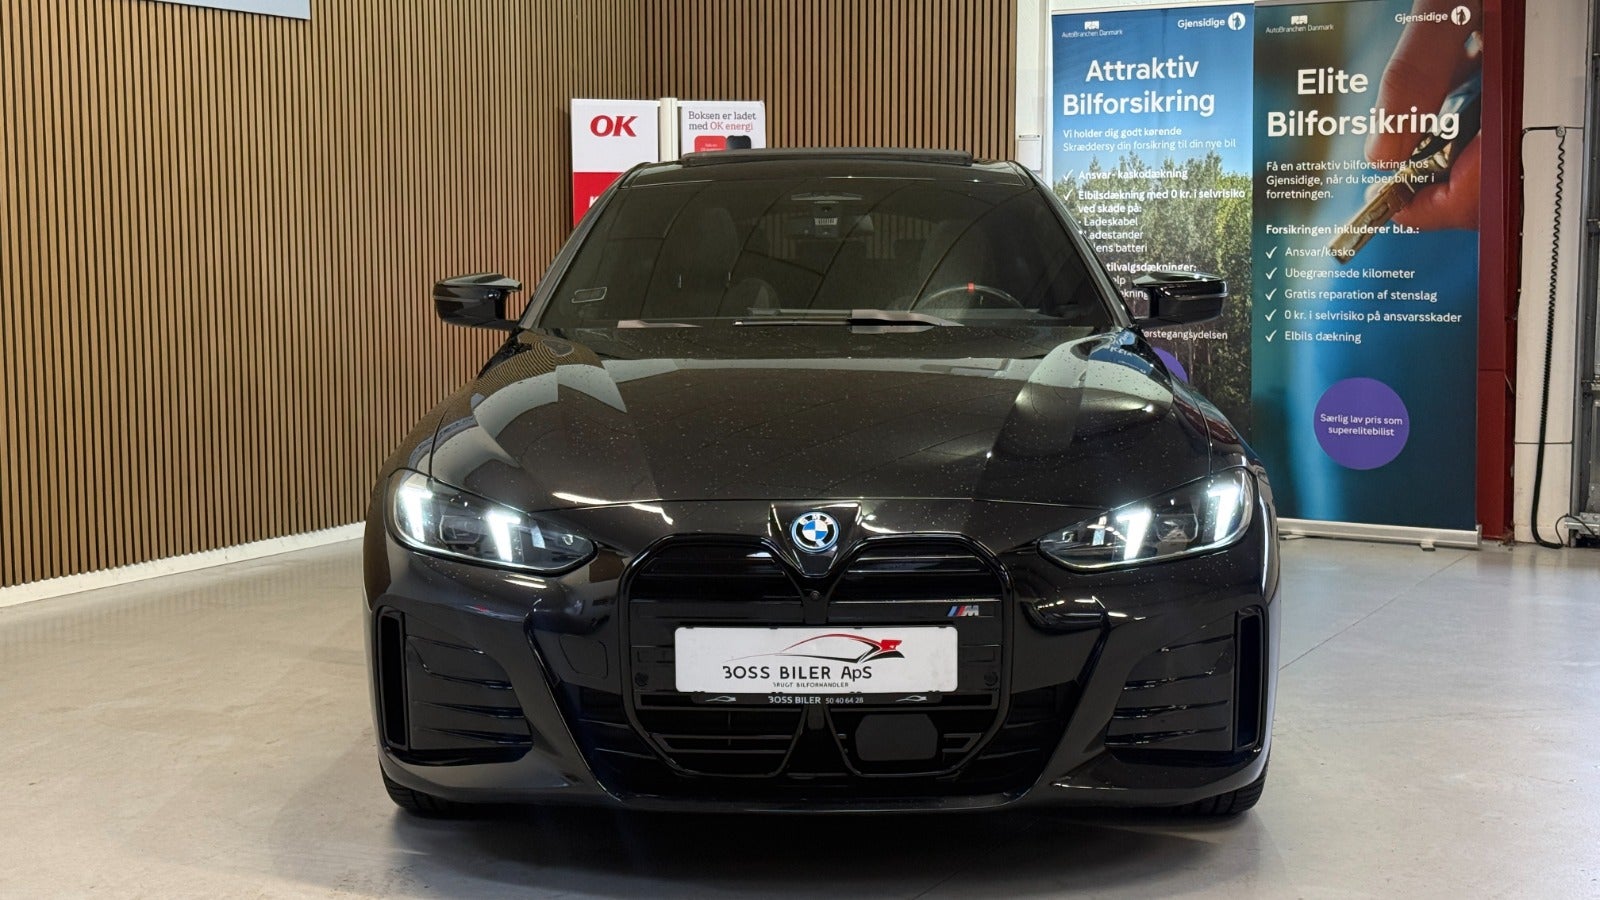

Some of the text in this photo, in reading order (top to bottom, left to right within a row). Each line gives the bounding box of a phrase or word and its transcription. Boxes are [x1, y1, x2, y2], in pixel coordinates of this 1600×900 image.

[1177, 18, 1225, 30] Gjensidige
[1395, 12, 1448, 25] Gjensidige
[1099, 29, 1123, 37] Danmark
[1307, 24, 1334, 32] Danmark
[1085, 55, 1199, 82] Attraktiv
[1297, 67, 1369, 95] Elite
[1063, 89, 1215, 117] Bilforsikring
[688, 111, 720, 121] Boksen
[734, 111, 756, 121] ladet
[590, 115, 638, 137] OK
[689, 122, 754, 132] med OK energi
[1267, 106, 1460, 140] Bilforsikring
[1063, 126, 1182, 140] Vi holder dig godt kørende
[1063, 138, 1236, 153] Skræddersy din forsikring til din nye bil
[1266, 159, 1428, 172] Få en attraktiv bilforsikring hos
[1078, 169, 1188, 180] Ansvar- kaskodækning
[1266, 173, 1323, 186] Gjensidige,
[1325, 173, 1343, 184] når
[1345, 174, 1359, 184] du
[1361, 173, 1392, 184] køber
[1394, 172, 1408, 183] bil
[1410, 172, 1428, 183] her
[1078, 190, 1145, 202] Elbilsdækning
[1147, 189, 1168, 199] med
[1170, 190, 1178, 199] 0
[1179, 190, 1192, 199] kr.
[1198, 189, 1245, 199] selvrisiko
[1266, 189, 1334, 200] forretningen.
[1078, 203, 1142, 214] ved skade på:
[1084, 218, 1138, 227] Ladeskabel
[1085, 231, 1144, 240] adestander
[1266, 224, 1419, 236] Forsikringen inkluderer bl.a.:
[1115, 243, 1148, 252] batteri
[1285, 247, 1355, 258] Ansvar/kasko
[1285, 268, 1415, 280] Ubegrænsede kilometer
[1284, 289, 1438, 303] Gratis reparation af stenslag
[1284, 311, 1292, 320] 0
[1293, 310, 1307, 320] kr.
[1315, 311, 1365, 321] selvrisiko
[1367, 310, 1380, 323] på
[1383, 312, 1462, 323] ansvarsskader
[1285, 331, 1362, 344] Elbils dækning
[1320, 413, 1403, 426] Særlig lav pris som
[1328, 426, 1395, 437] superelitebilist
[780, 665, 831, 679] BILER
[840, 665, 873, 682] ApS
[795, 695, 821, 705] BILER
[825, 696, 834, 704] 50
[835, 696, 844, 704] 40
[845, 696, 854, 704] 64
[855, 696, 864, 704] 28
